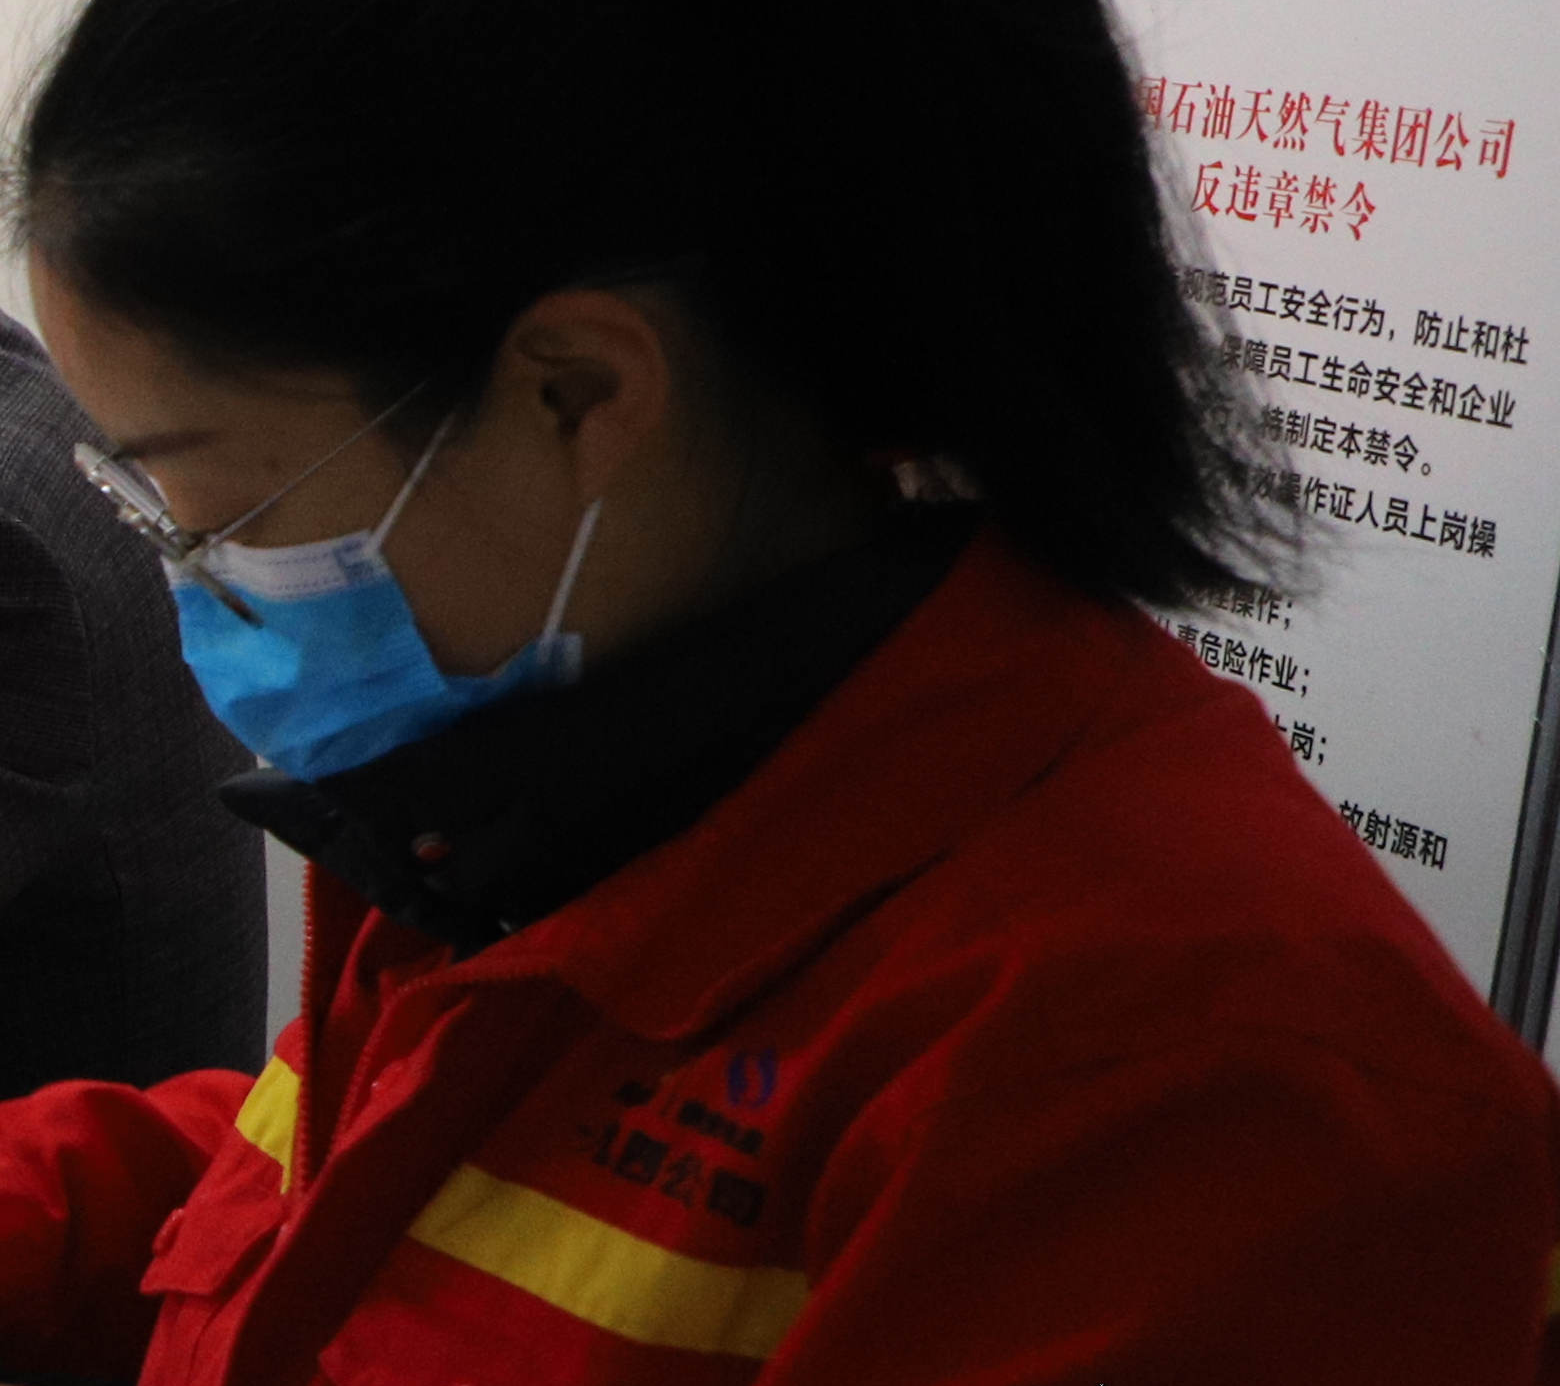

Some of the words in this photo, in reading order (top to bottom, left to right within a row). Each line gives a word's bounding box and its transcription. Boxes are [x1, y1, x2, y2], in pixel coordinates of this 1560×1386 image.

[1190, 160, 1377, 242] 反违章禁令
[1174, 268, 1530, 366] 规范员工安全行为，防止和杜
[1230, 462, 1497, 560] 效操作证人员上岗操
